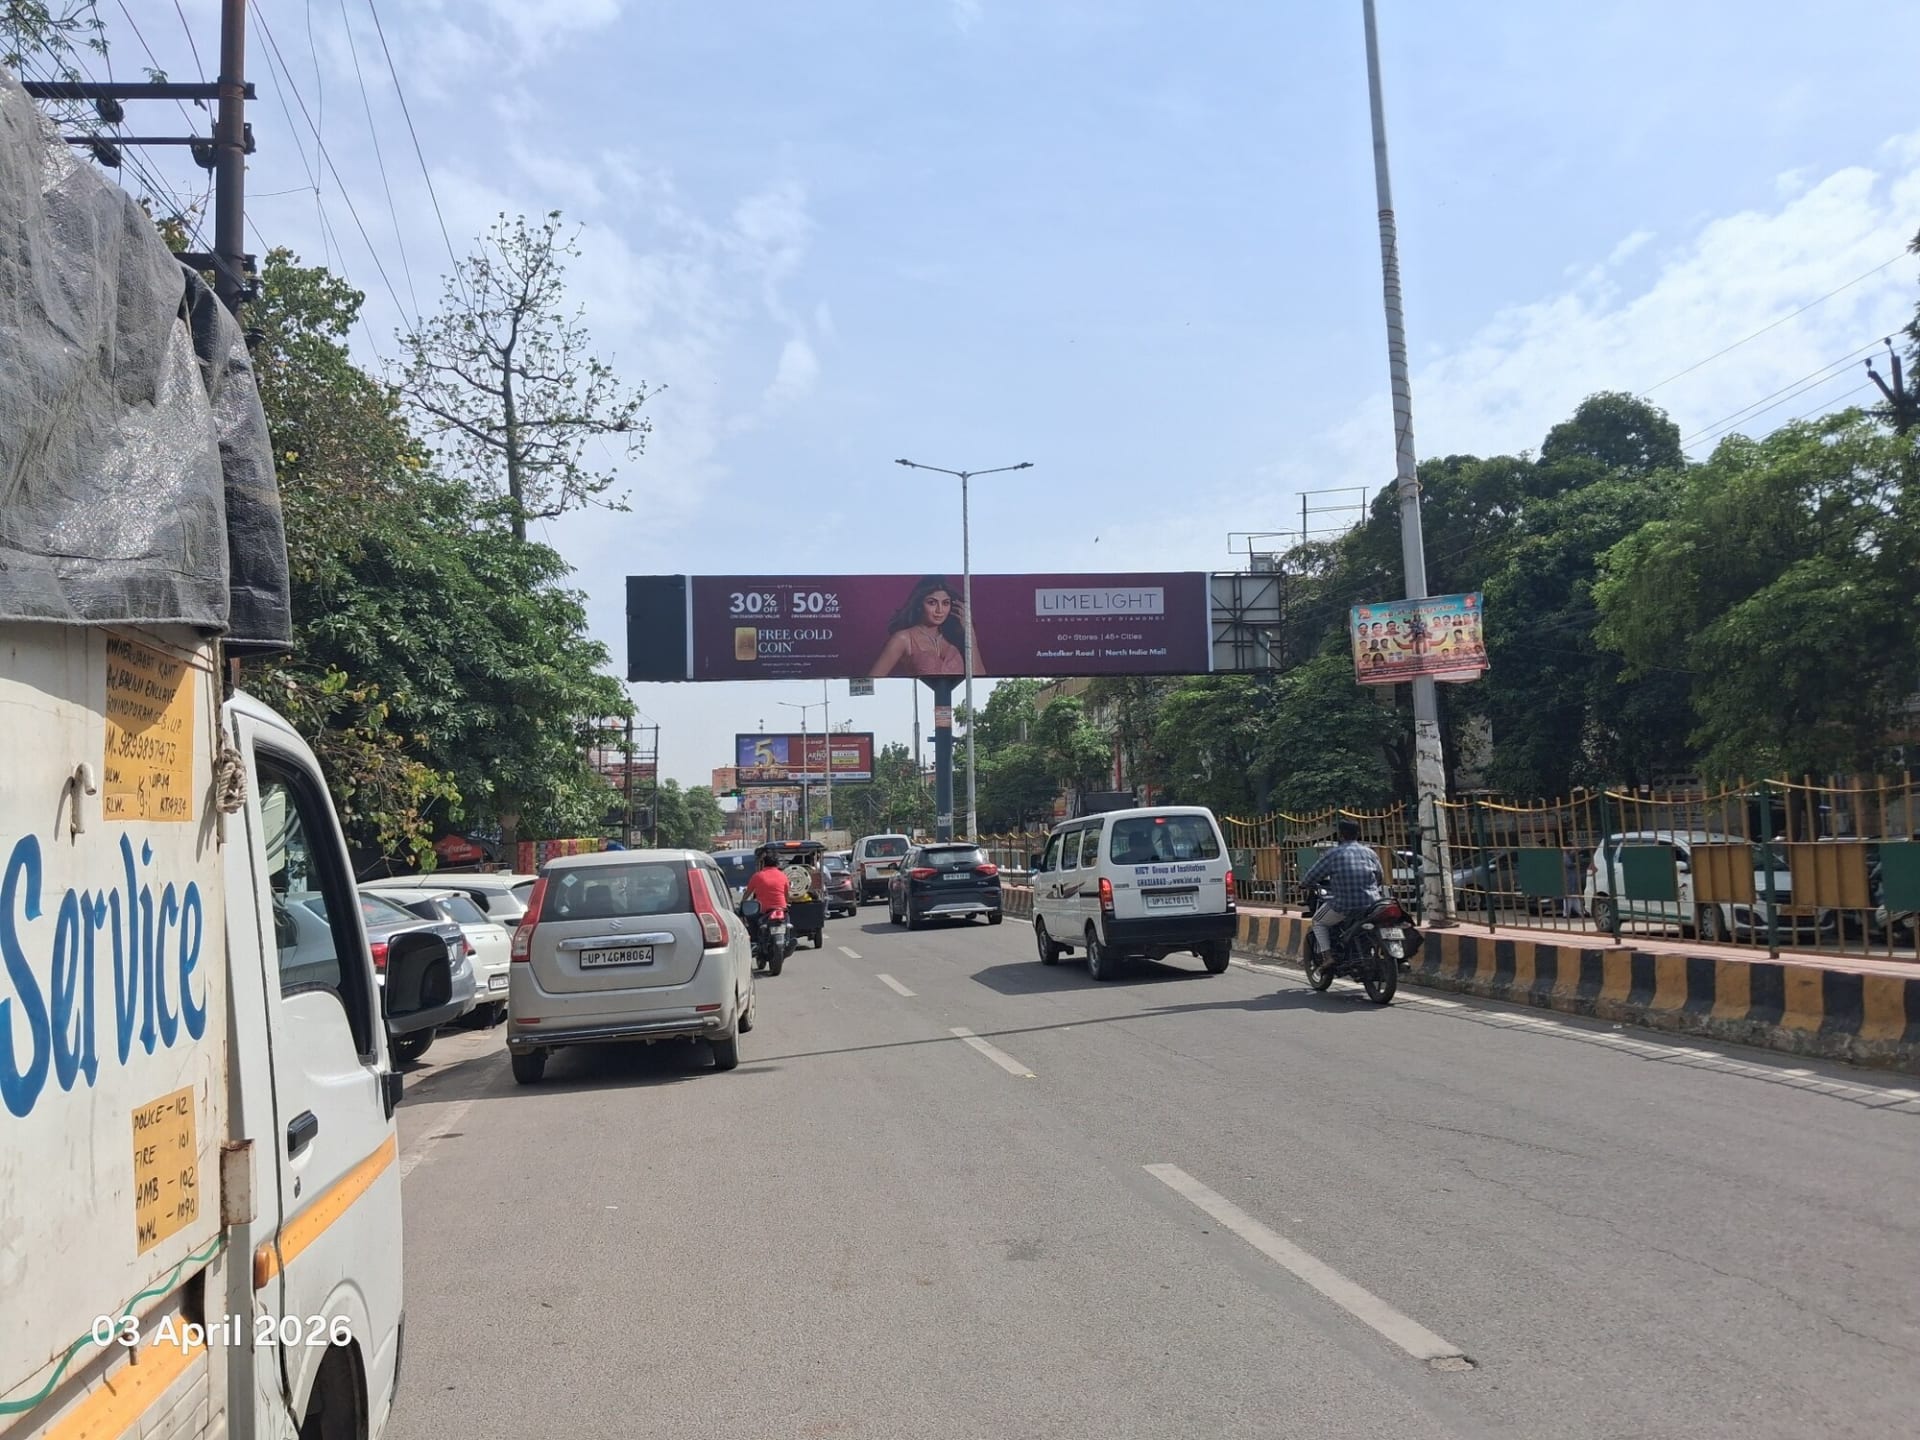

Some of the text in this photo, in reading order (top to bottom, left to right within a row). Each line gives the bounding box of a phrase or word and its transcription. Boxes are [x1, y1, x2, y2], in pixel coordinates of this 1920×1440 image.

[729, 592, 777, 613] 30%
[792, 592, 838, 613] 50%
[758, 629, 833, 640] FREE GOLD
[1036, 648, 1073, 657] Ambedkar
[1075, 648, 1095, 656] Road
[1105, 648, 1128, 656] North
[1128, 648, 1148, 656] India
[1149, 647, 1167, 655] Mall
[1152, 865, 1169, 874] Group
[588, 950, 651, 964] UP14GM8064
[0, 832, 207, 1118] Service
[134, 1104, 165, 1132] POLICE
[176, 1096, 189, 1116] 112
[135, 1144, 157, 1170] FIRE
[178, 1129, 189, 1151] 101
[136, 1176, 159, 1210] AMB
[180, 1165, 195, 1190] 102
